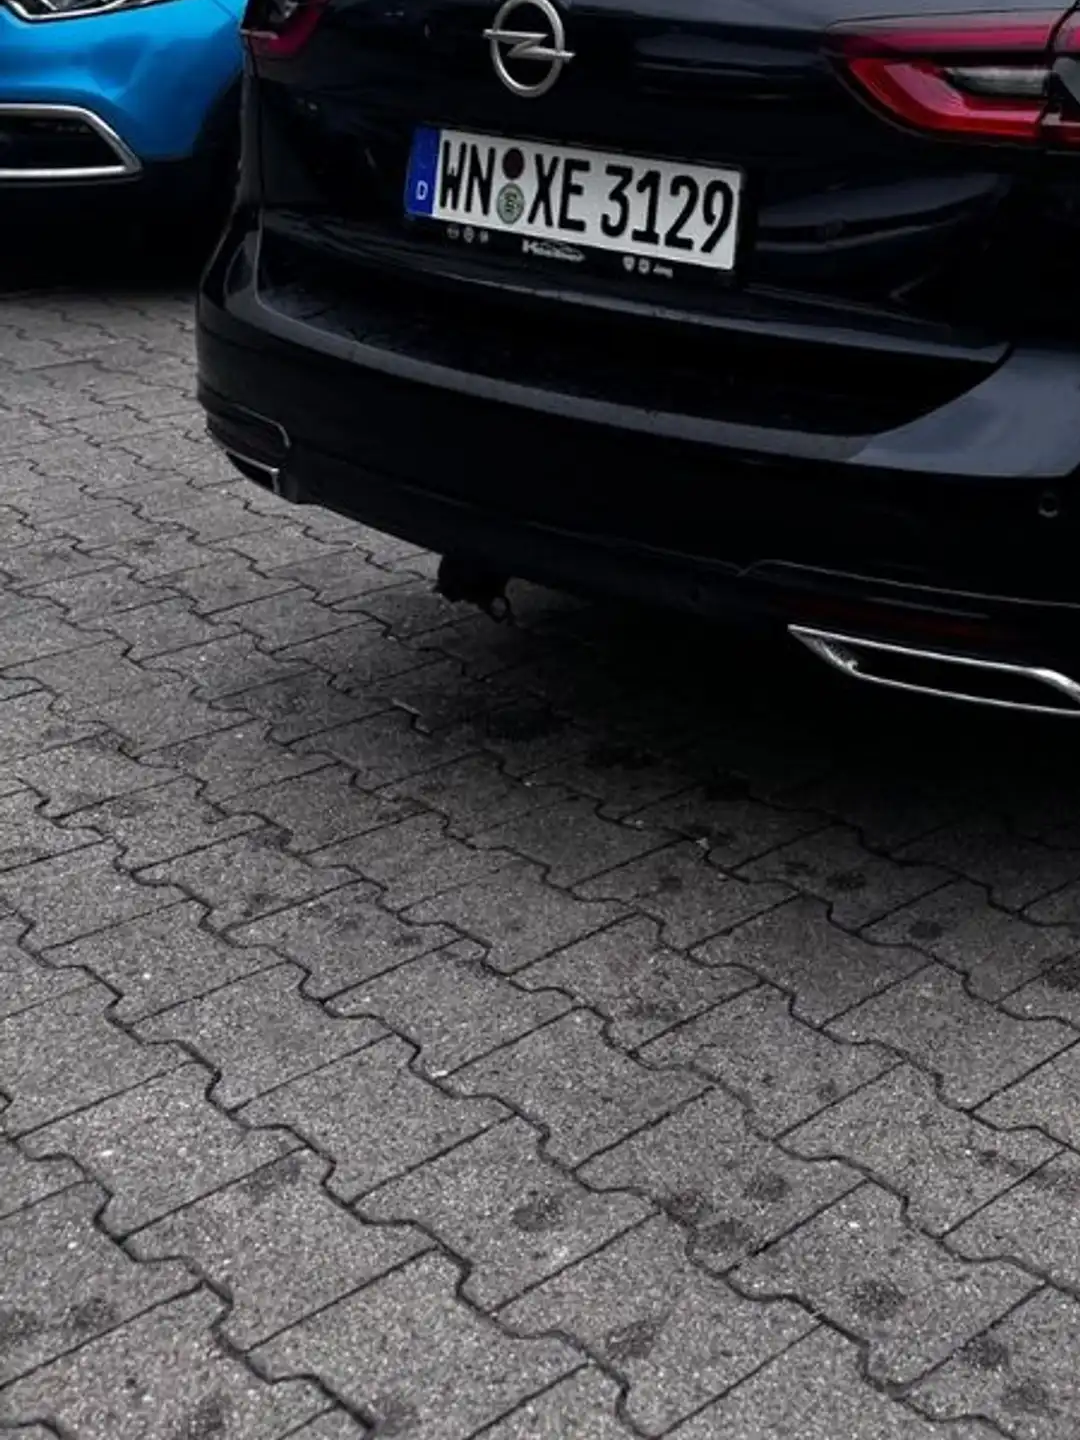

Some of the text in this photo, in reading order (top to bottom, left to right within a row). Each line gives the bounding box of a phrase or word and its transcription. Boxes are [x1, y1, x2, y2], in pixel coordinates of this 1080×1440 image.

[415, 180, 429, 201] D
[439, 140, 734, 253] WN XE 3129
